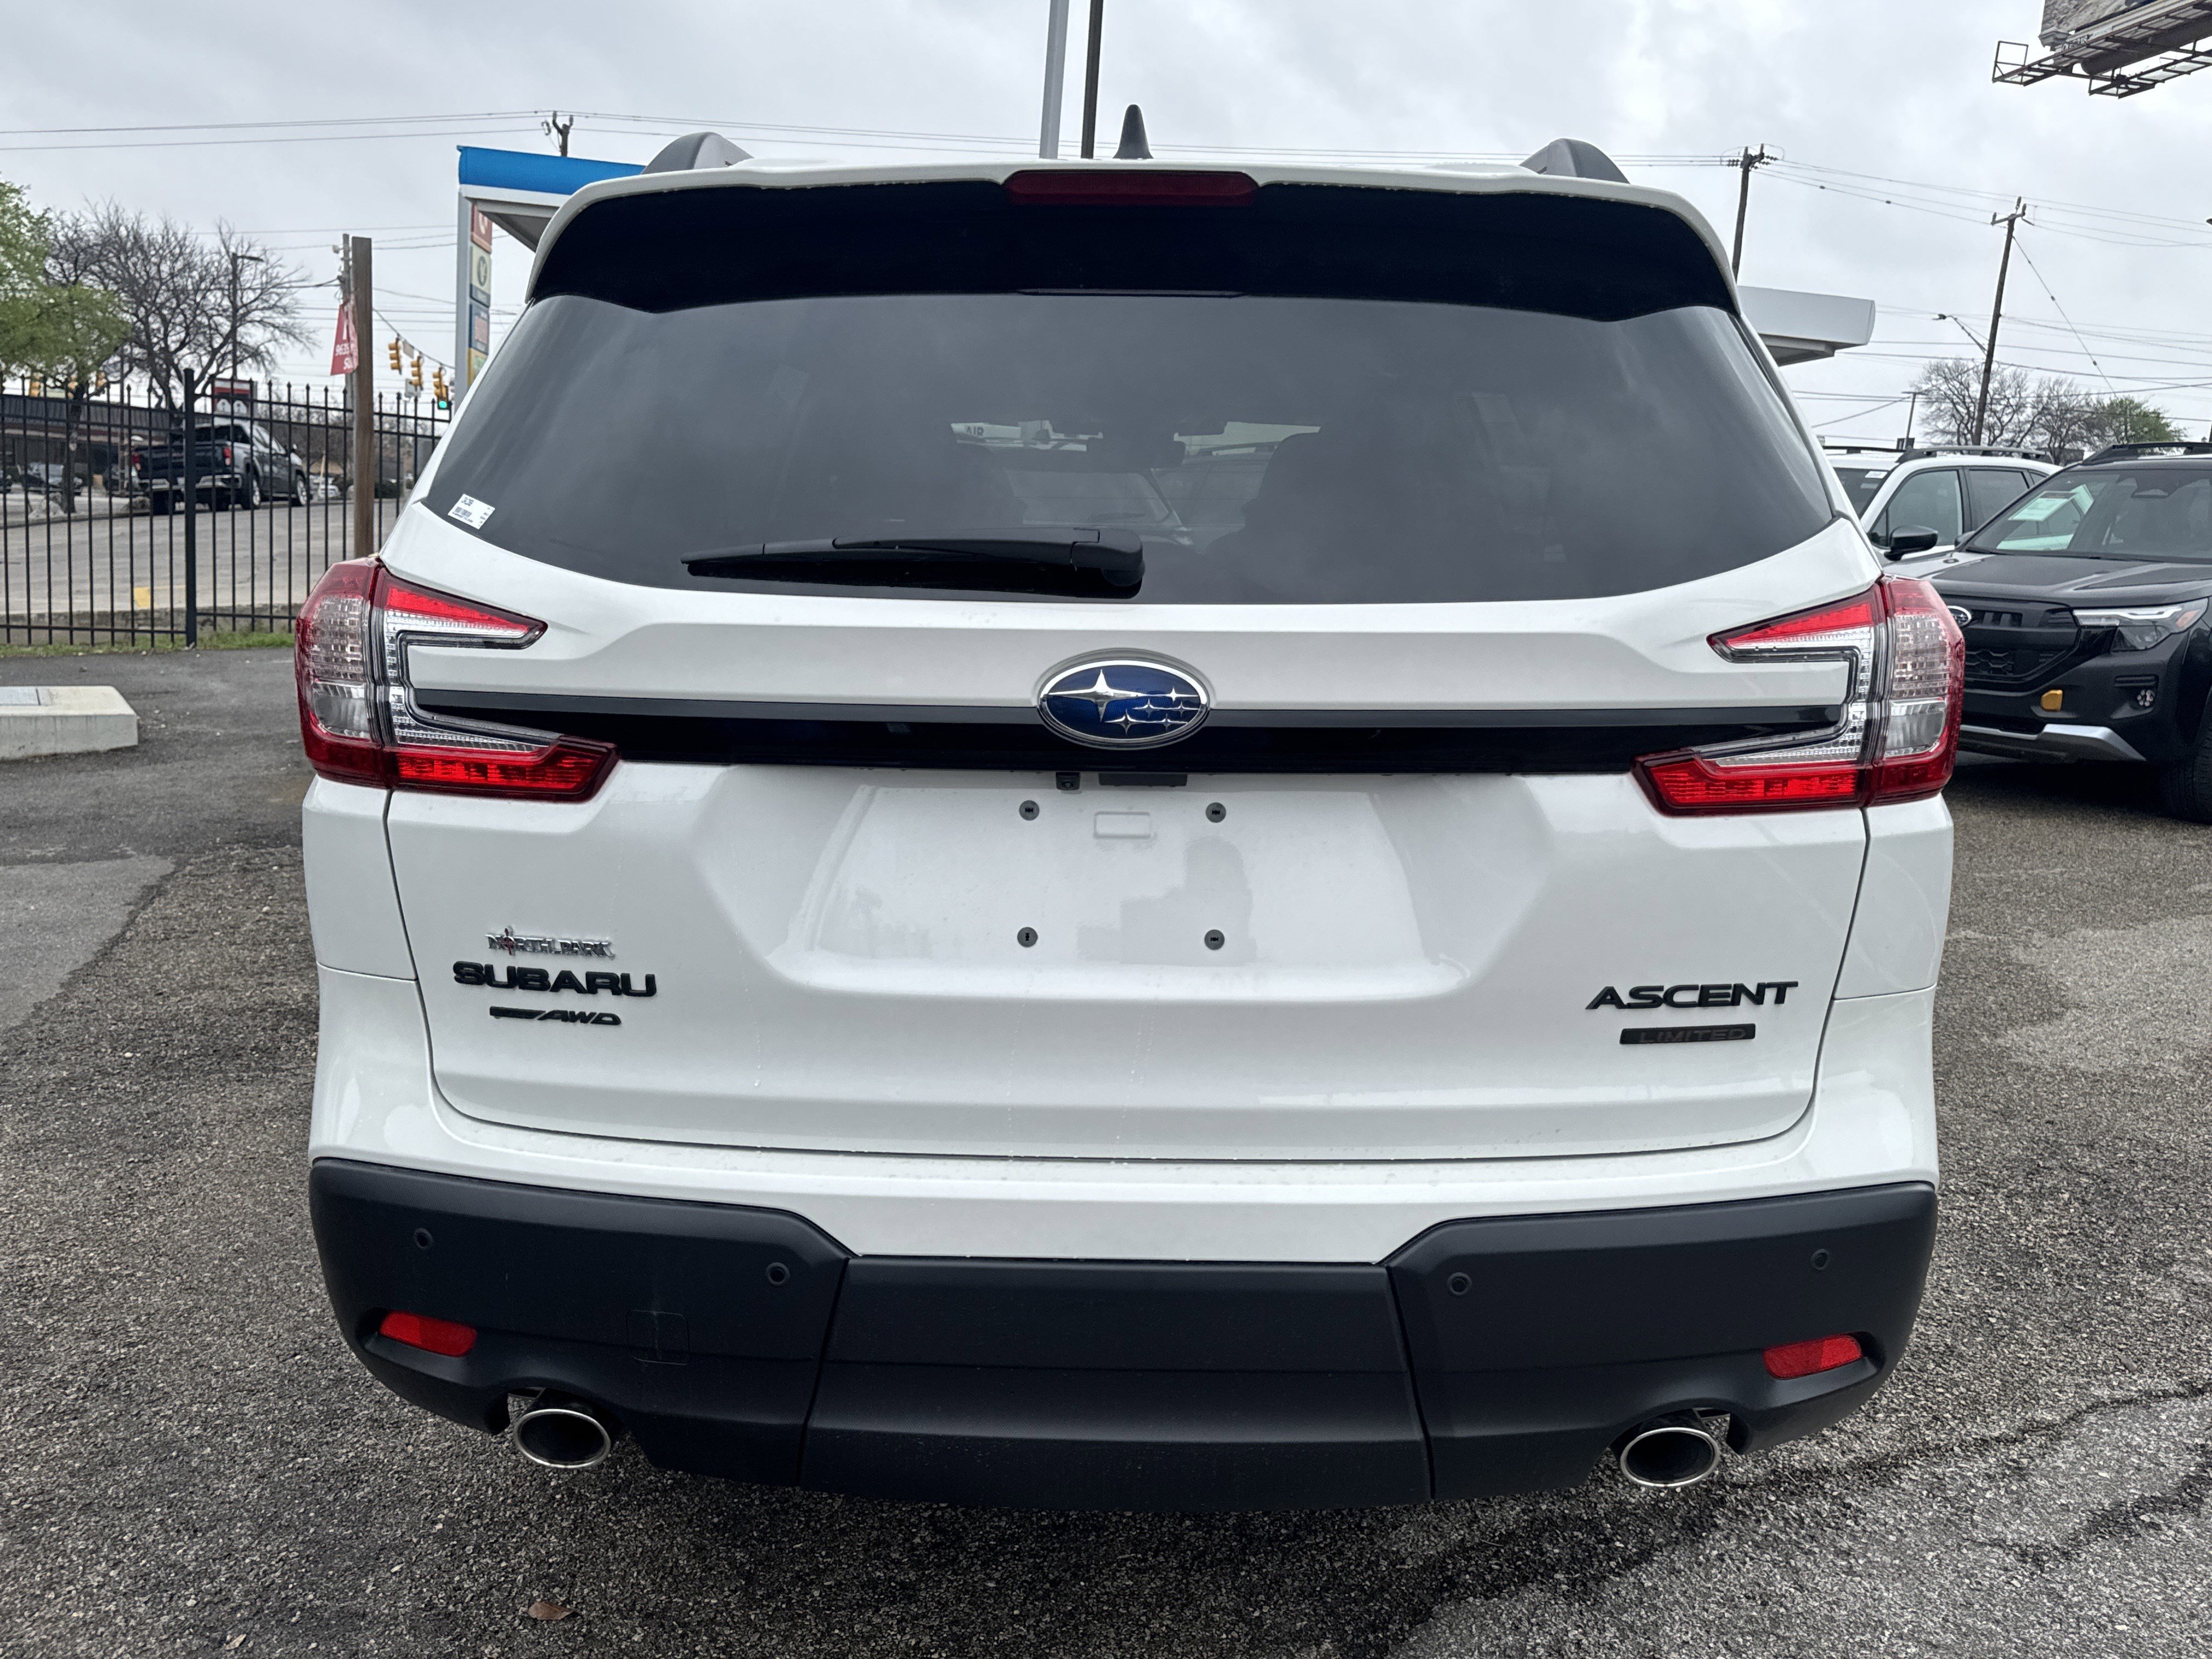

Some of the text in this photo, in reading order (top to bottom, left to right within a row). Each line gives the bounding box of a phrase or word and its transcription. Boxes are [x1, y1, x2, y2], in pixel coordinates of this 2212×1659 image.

[453, 961, 657, 997] SUBARU
[1585, 981, 1798, 1010] ASCENT
[537, 1009, 622, 1025] AWD
[1639, 1028, 1747, 1043] LIMITED
